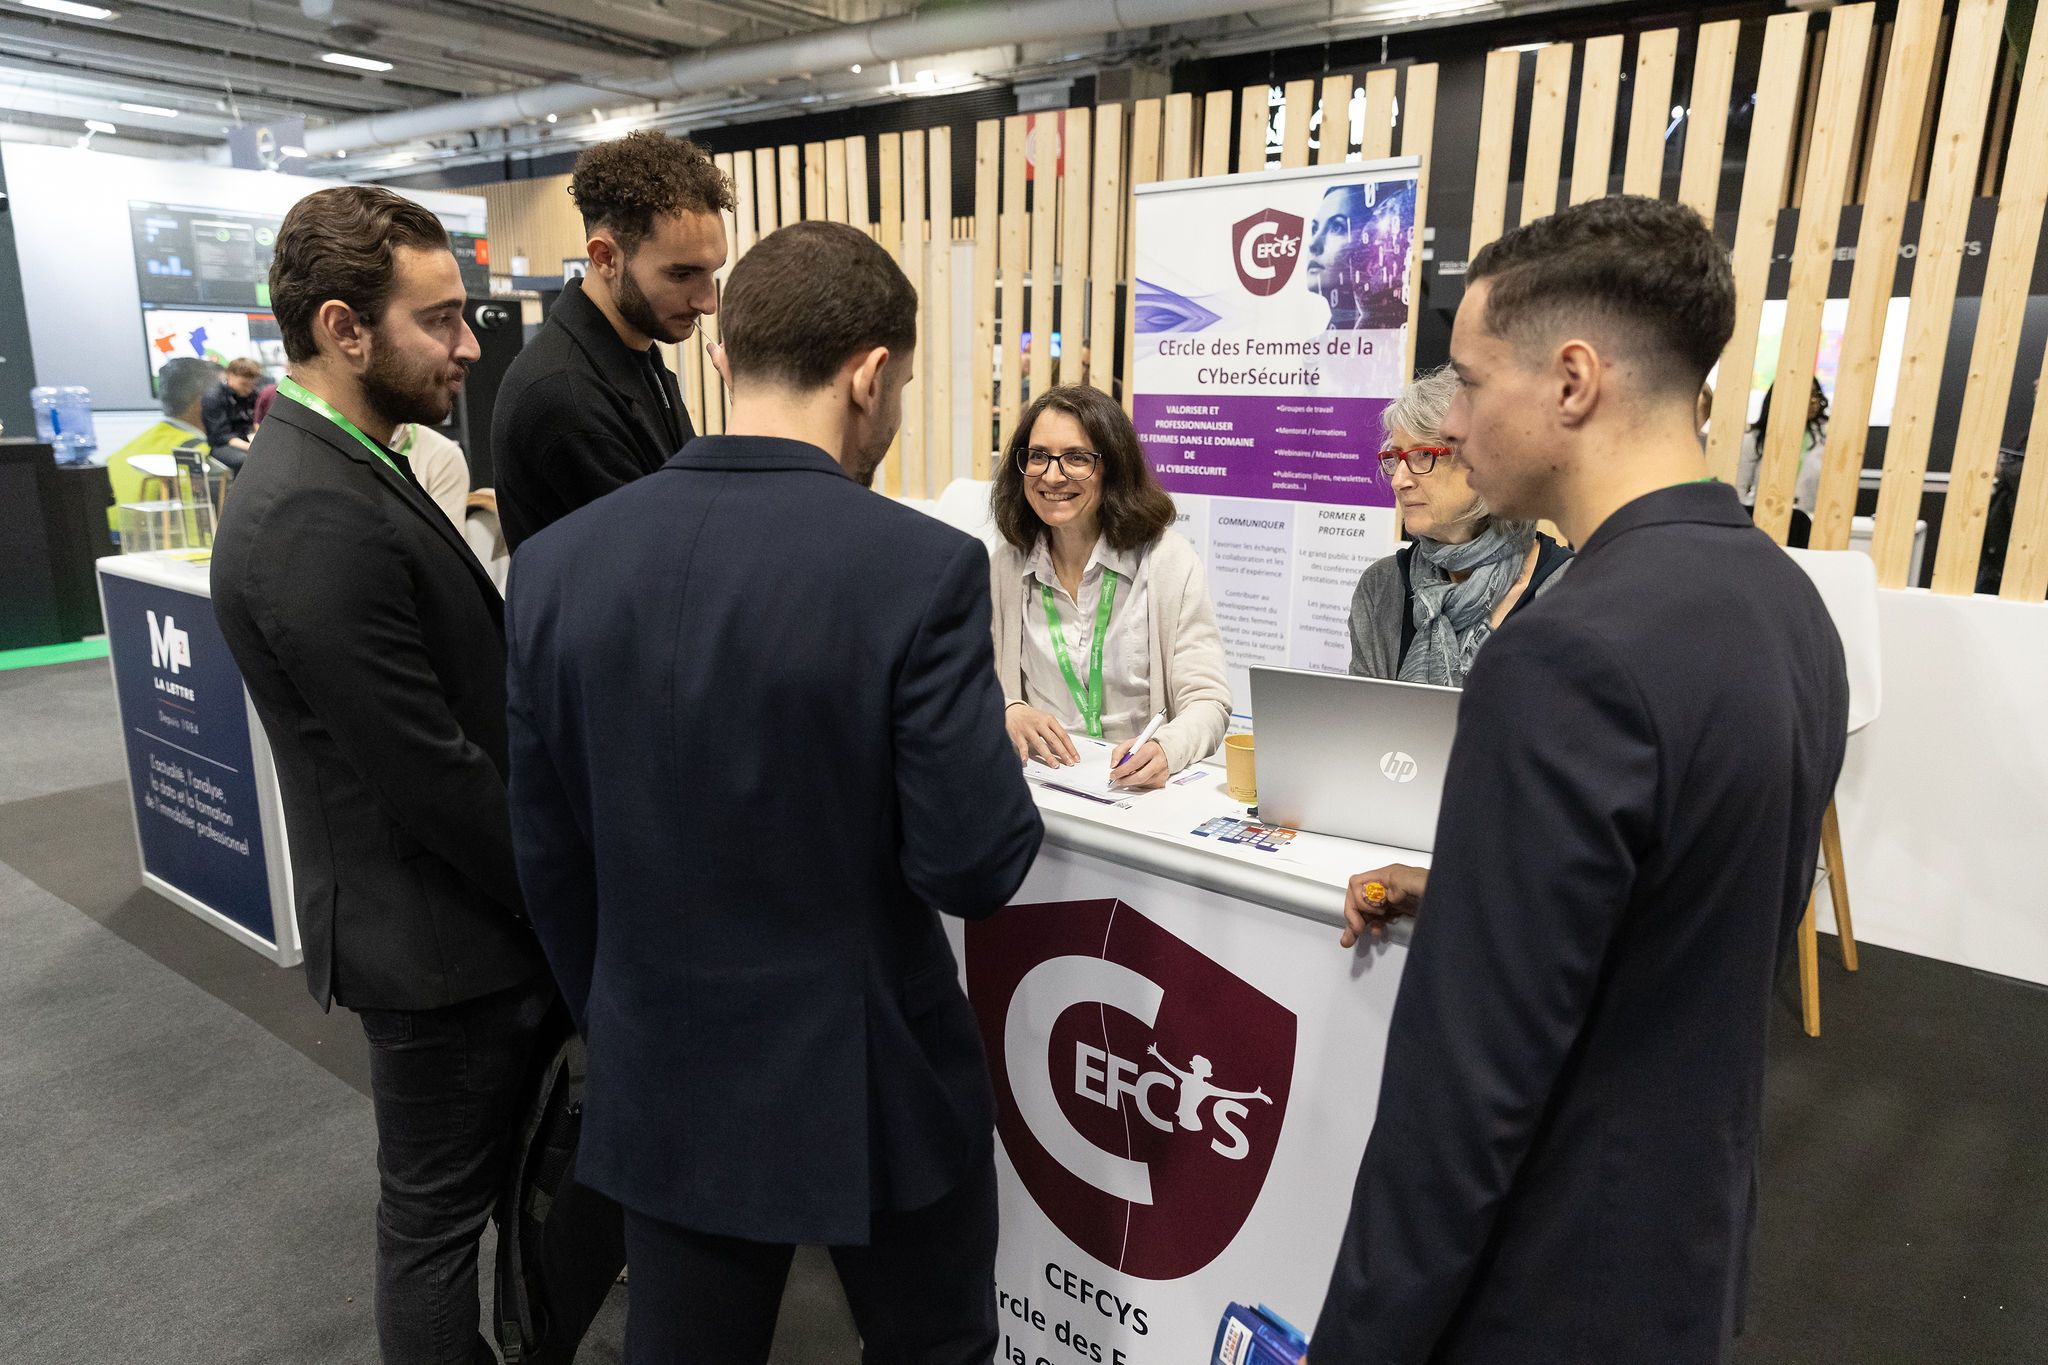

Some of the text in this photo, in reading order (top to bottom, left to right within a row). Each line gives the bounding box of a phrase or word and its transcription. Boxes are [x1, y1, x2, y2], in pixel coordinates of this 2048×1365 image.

[1159, 336, 1373, 356] CErcle des Femmes de la
[1198, 366, 1320, 386] CYberSécurité
[1166, 405, 1219, 415] VALORISER ET
[1280, 405, 1305, 413] Groupes
[1155, 420, 1233, 430] PROFESSIONNALISER
[1279, 427, 1307, 435] Mentorat
[1312, 428, 1347, 437] Formations
[1149, 434, 1178, 444] FEMMES
[1180, 435, 1202, 445] DANS
[1204, 436, 1213, 445] LE
[1214, 437, 1254, 447] DOMAINE
[1184, 450, 1195, 460] DE
[1277, 450, 1311, 458] Webinaires
[1315, 451, 1359, 460] Masterclasses
[1156, 464, 1227, 476] LA CYBERSECURITE
[1276, 471, 1312, 480] Publications
[1318, 510, 1366, 521] FORMER &
[1218, 517, 1285, 530] COMMUNIQUER
[1318, 526, 1365, 537] PROTEGER
[1213, 540, 1241, 548] Favoriser
[1243, 542, 1253, 550] les
[1222, 553, 1265, 563] collaboration
[1265, 557, 1273, 565] et
[1274, 558, 1284, 566] les
[1308, 550, 1327, 558] grand
[1328, 552, 1350, 561] public
[1216, 566, 1239, 574] retours
[1311, 563, 1322, 571] des
[1302, 575, 1339, 585] prestations
[1225, 589, 1260, 600] Contribuer
[1268, 607, 1278, 615] du
[1308, 600, 1318, 608] Les
[1320, 602, 1341, 612] jeunes
[1238, 615, 1250, 623] des
[1251, 617, 1278, 627] femmes
[1252, 630, 1279, 639] aspirant
[1299, 623, 1343, 637] interventions
[1235, 639, 1250, 647] dans
[1309, 661, 1320, 670] Les
[154, 676, 195, 702] LA LETTRE
[160, 778, 177, 800] data
[194, 793, 234, 827] formation
[197, 820, 250, 857] professionnel
[1045, 1262, 1149, 1336] CEFCYS
[1054, 1319, 1102, 1363] des
[1005, 1334, 1026, 1365] la
